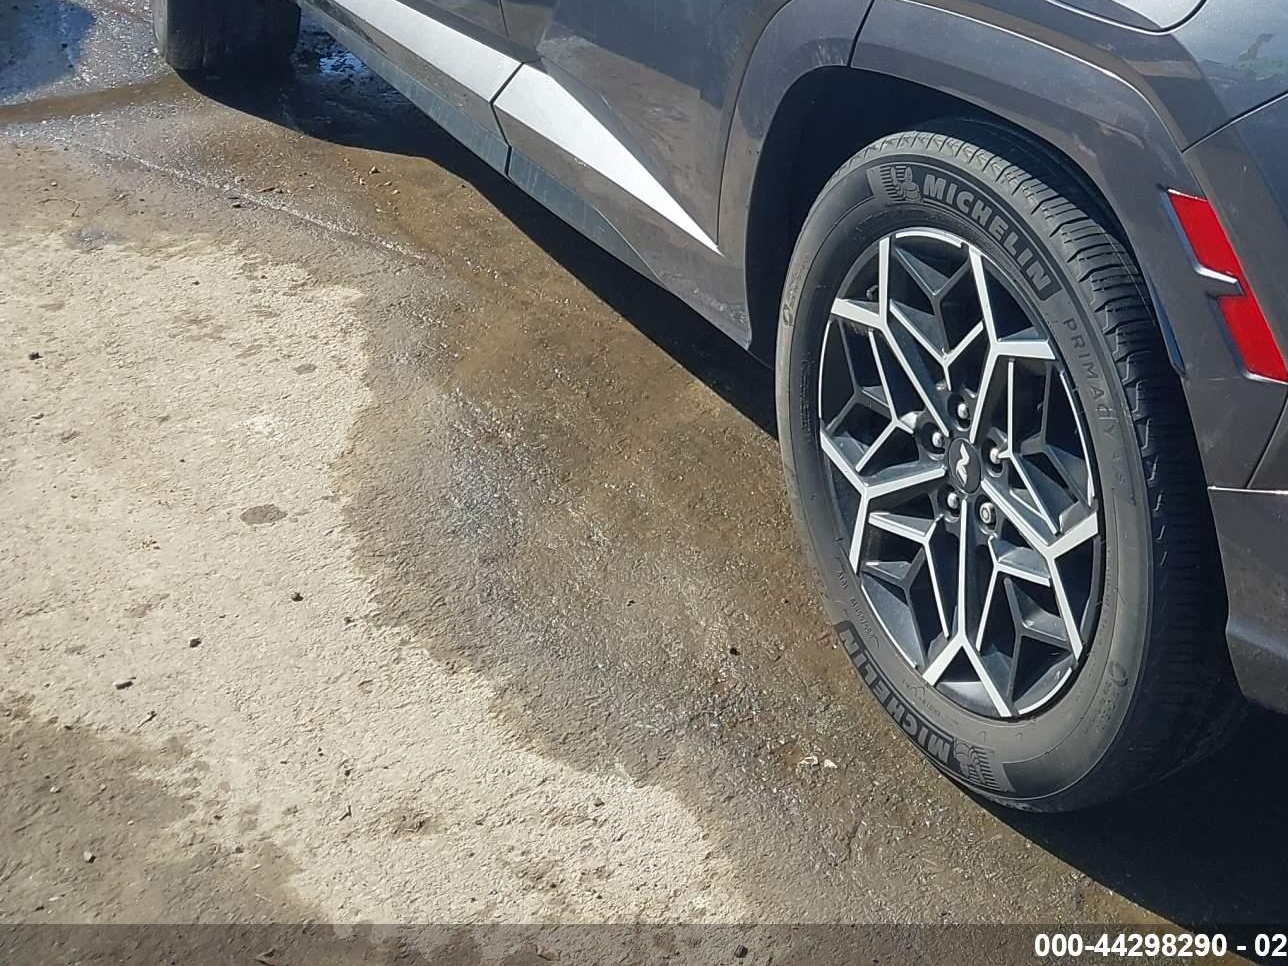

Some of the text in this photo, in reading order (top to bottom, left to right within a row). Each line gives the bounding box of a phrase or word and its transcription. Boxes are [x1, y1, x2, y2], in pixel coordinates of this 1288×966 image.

[922, 173, 1052, 292] MICHELIN
[1062, 316, 1116, 437] PRIMACY
[840, 628, 951, 760] MICHELIN
